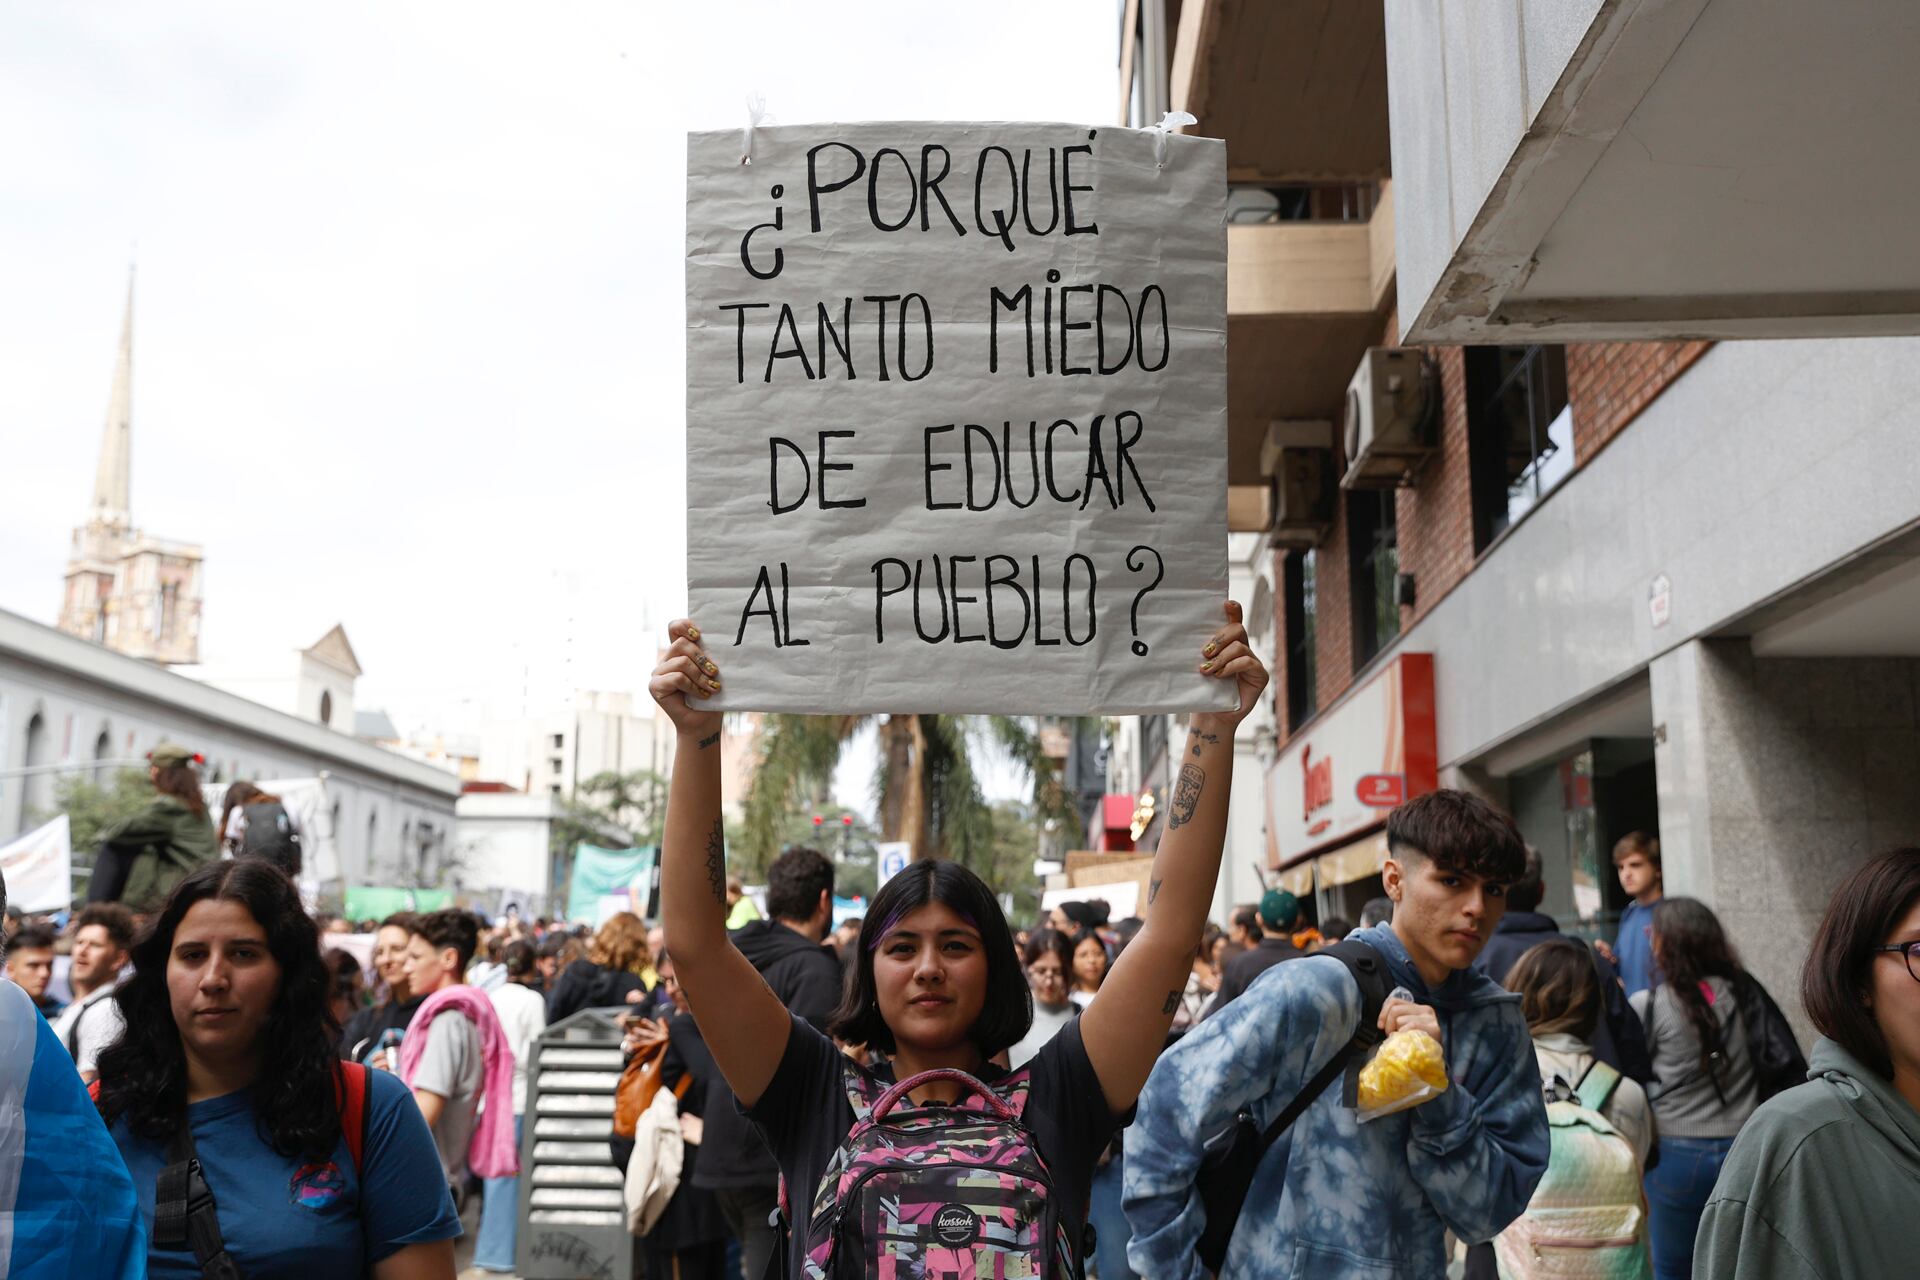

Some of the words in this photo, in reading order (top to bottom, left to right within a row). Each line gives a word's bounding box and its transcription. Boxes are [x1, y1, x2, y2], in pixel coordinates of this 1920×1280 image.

[718, 292, 934, 384] TANTO
[766, 430, 867, 516] DE
[924, 410, 1156, 514] EDUCAR
[733, 562, 811, 649] AL
[937, 1213, 974, 1227] kossok
